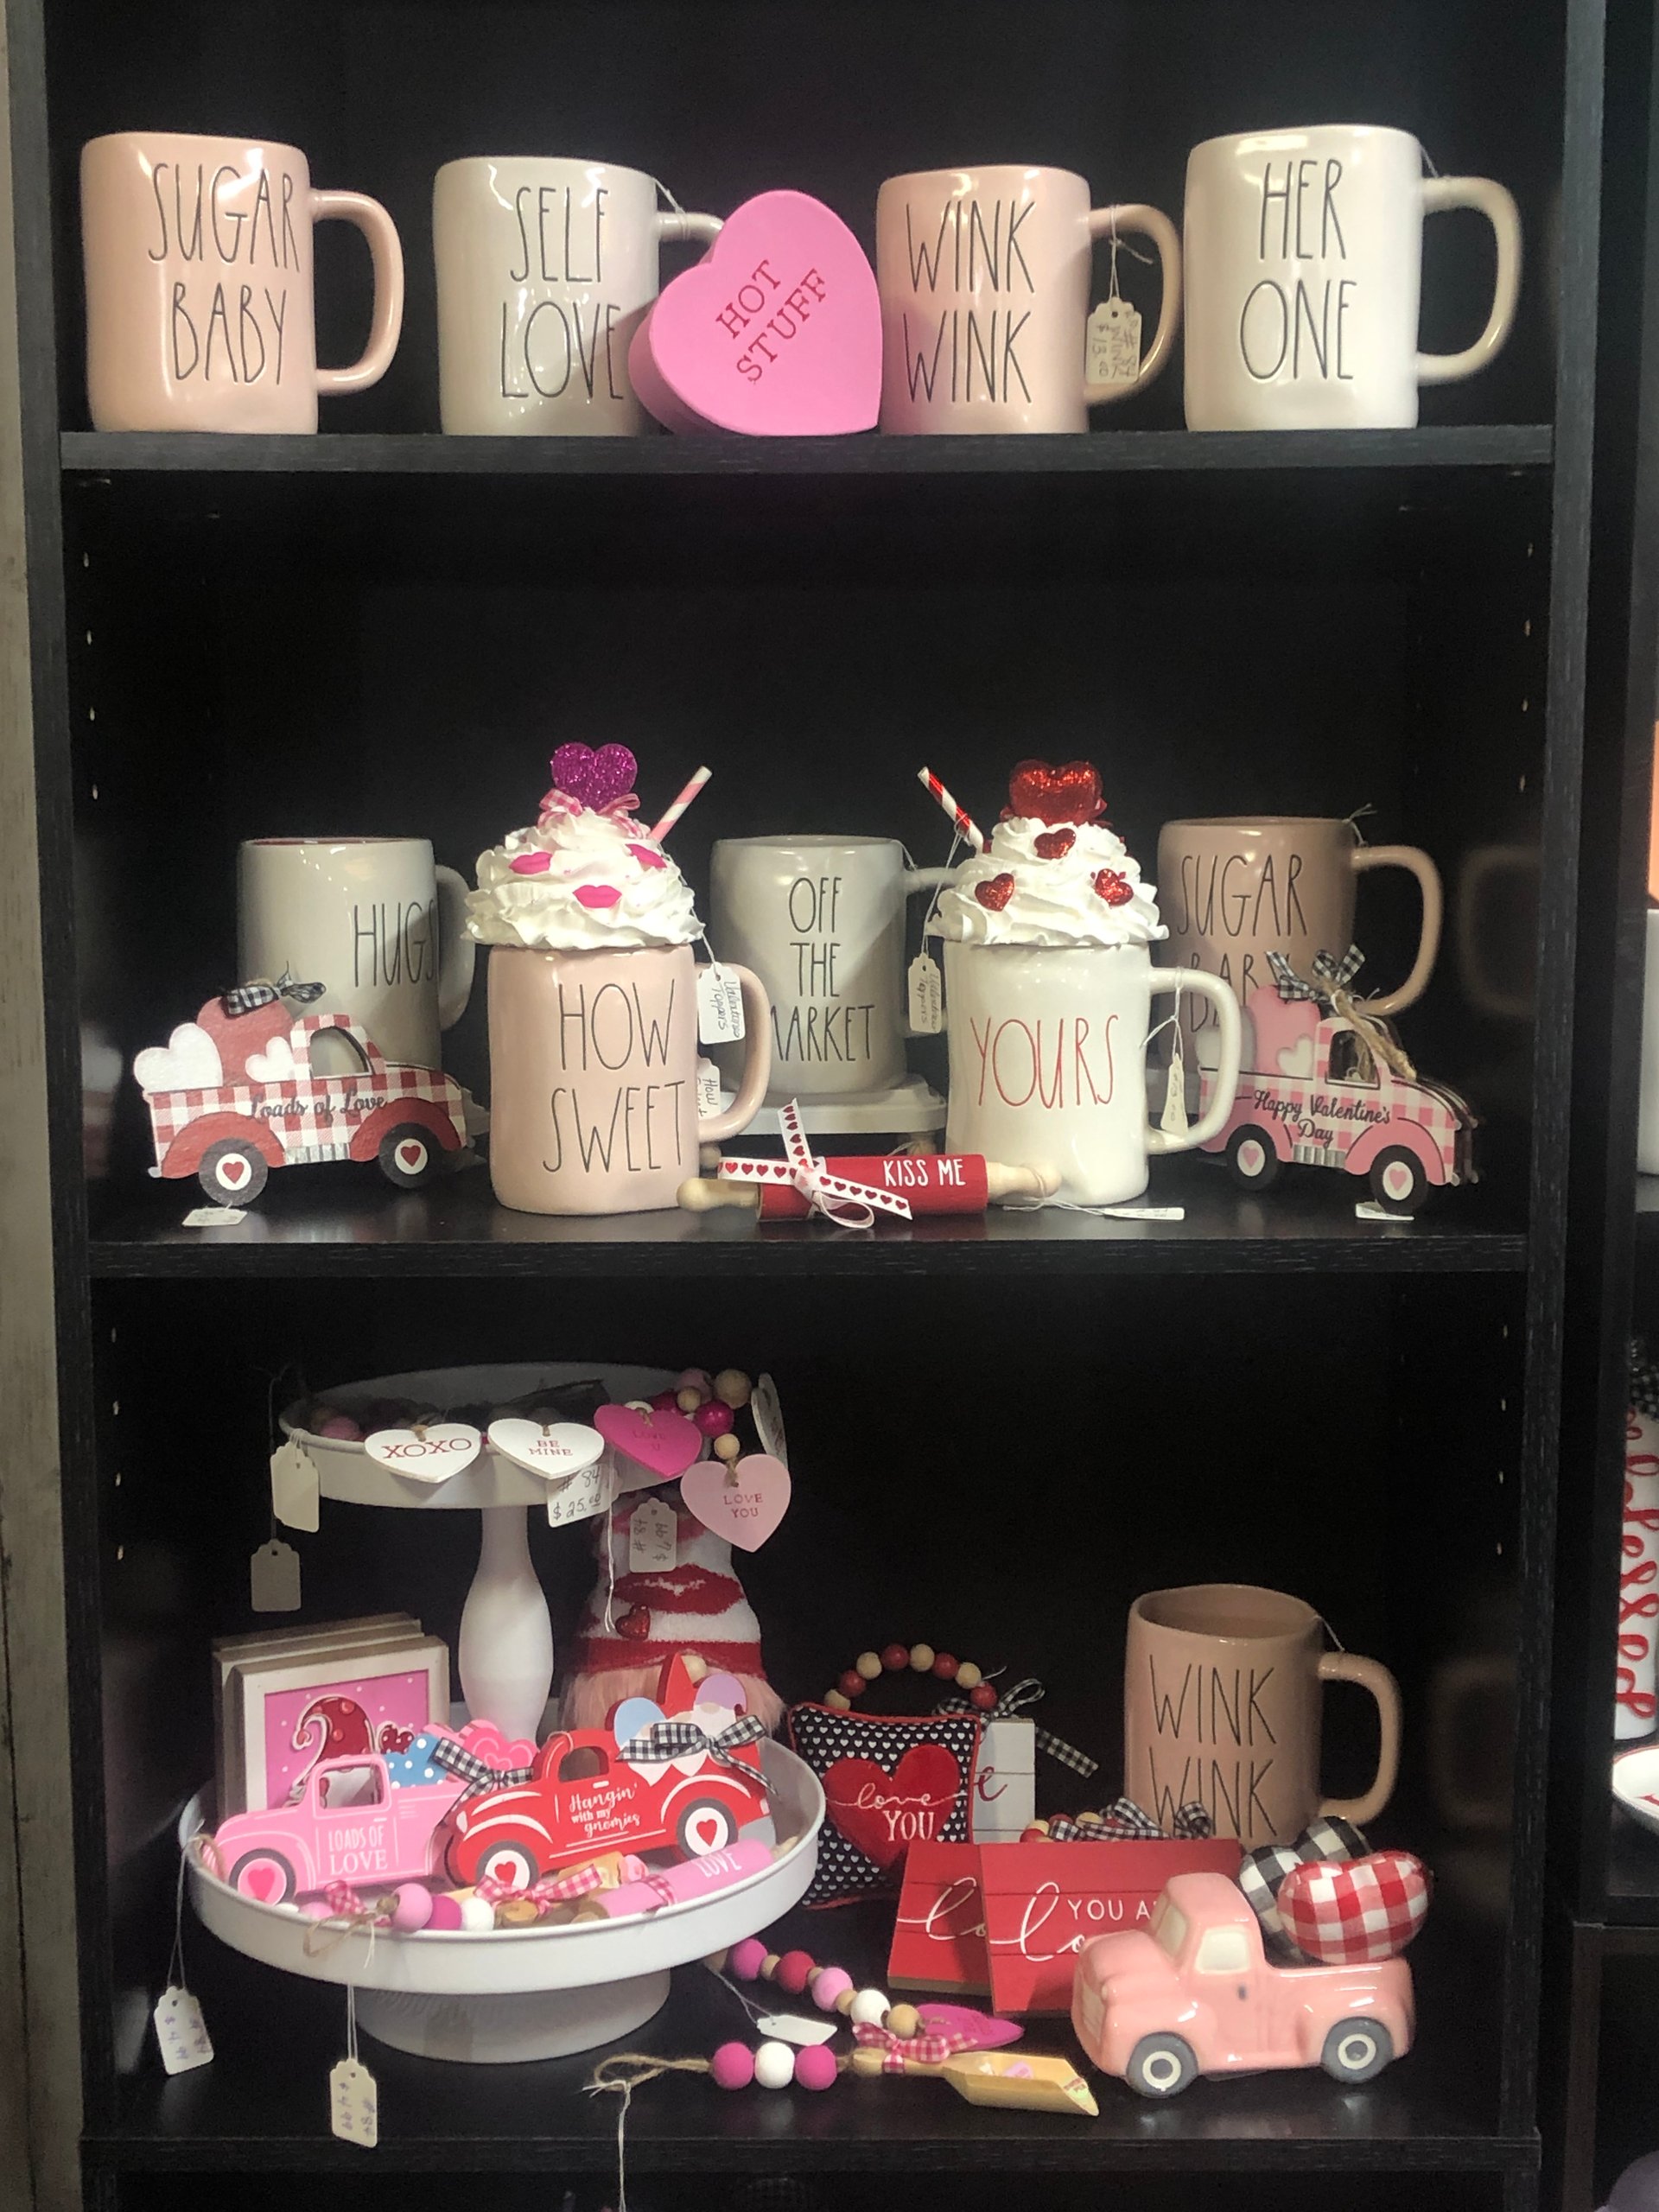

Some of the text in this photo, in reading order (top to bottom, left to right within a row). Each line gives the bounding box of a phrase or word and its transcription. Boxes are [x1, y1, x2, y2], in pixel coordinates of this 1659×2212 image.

[149, 163, 299, 271] SUGAR
[1260, 159, 1346, 259] HER
[511, 188, 608, 283] SELF
[906, 200, 1035, 293] WINK
[715, 260, 781, 340] HOT
[173, 283, 286, 385] BABY
[736, 269, 827, 385] STUFF
[1240, 279, 1357, 379] ONE
[501, 302, 623, 399] LOVE
[903, 310, 1032, 404] WINK
[789, 877, 842, 933] OFF
[1177, 854, 1307, 937] SUGAR
[790, 943, 841, 996] THE
[559, 980, 675, 1071] HOW
[970, 1014, 1118, 1109] YOURS
[248, 1088, 385, 1124] Loads of Love
[543, 1081, 685, 1173] SWEET
[1254, 1089, 1390, 1124] Happy Valentine's
[1298, 1118, 1334, 1148] Day
[883, 1158, 966, 1187] KISS ME
[382, 1438, 472, 1459] XOXO
[528, 1447, 573, 1457] MINE
[536, 1440, 560, 1448] BE
[724, 1492, 764, 1505] LOVE
[731, 1507, 759, 1518] YOU
[1149, 1654, 1277, 1746] WINK
[569, 1783, 638, 1813] Hangin'
[827, 1783, 969, 1810] love
[1149, 1745, 1277, 1839] WINK
[328, 1824, 385, 1850] LOADS OF
[571, 1808, 612, 1825] with my
[584, 1813, 640, 1839] gnomies
[882, 1810, 934, 1841] YOU
[330, 1849, 388, 1876] LOVE
[691, 1851, 742, 1878] LOVE
[1067, 1899, 1158, 1921] YOU A
